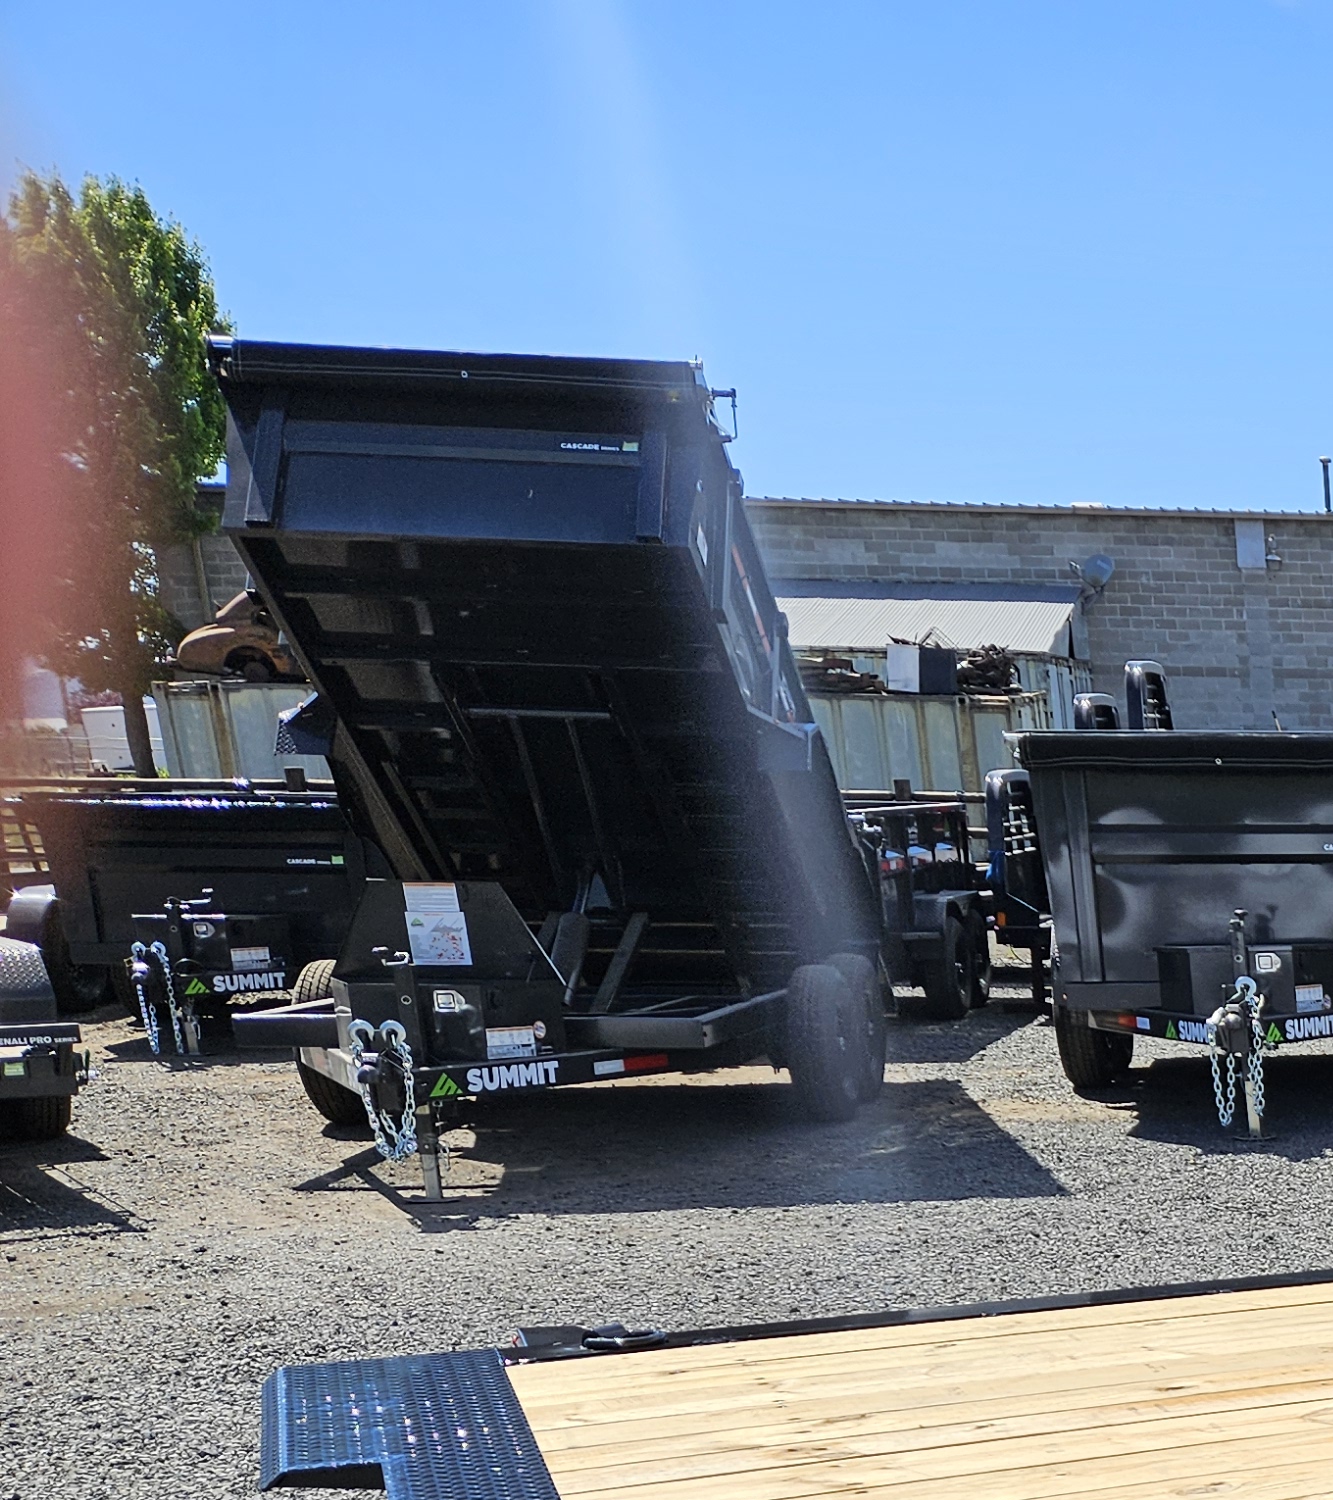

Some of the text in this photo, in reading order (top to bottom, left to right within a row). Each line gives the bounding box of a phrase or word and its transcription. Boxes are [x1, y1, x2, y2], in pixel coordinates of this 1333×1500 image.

[560, 442, 600, 451] CASCADE
[212, 971, 285, 993] SUMMIT
[29, 1035, 53, 1045] PRO
[466, 1060, 560, 1093] SUMMIT
